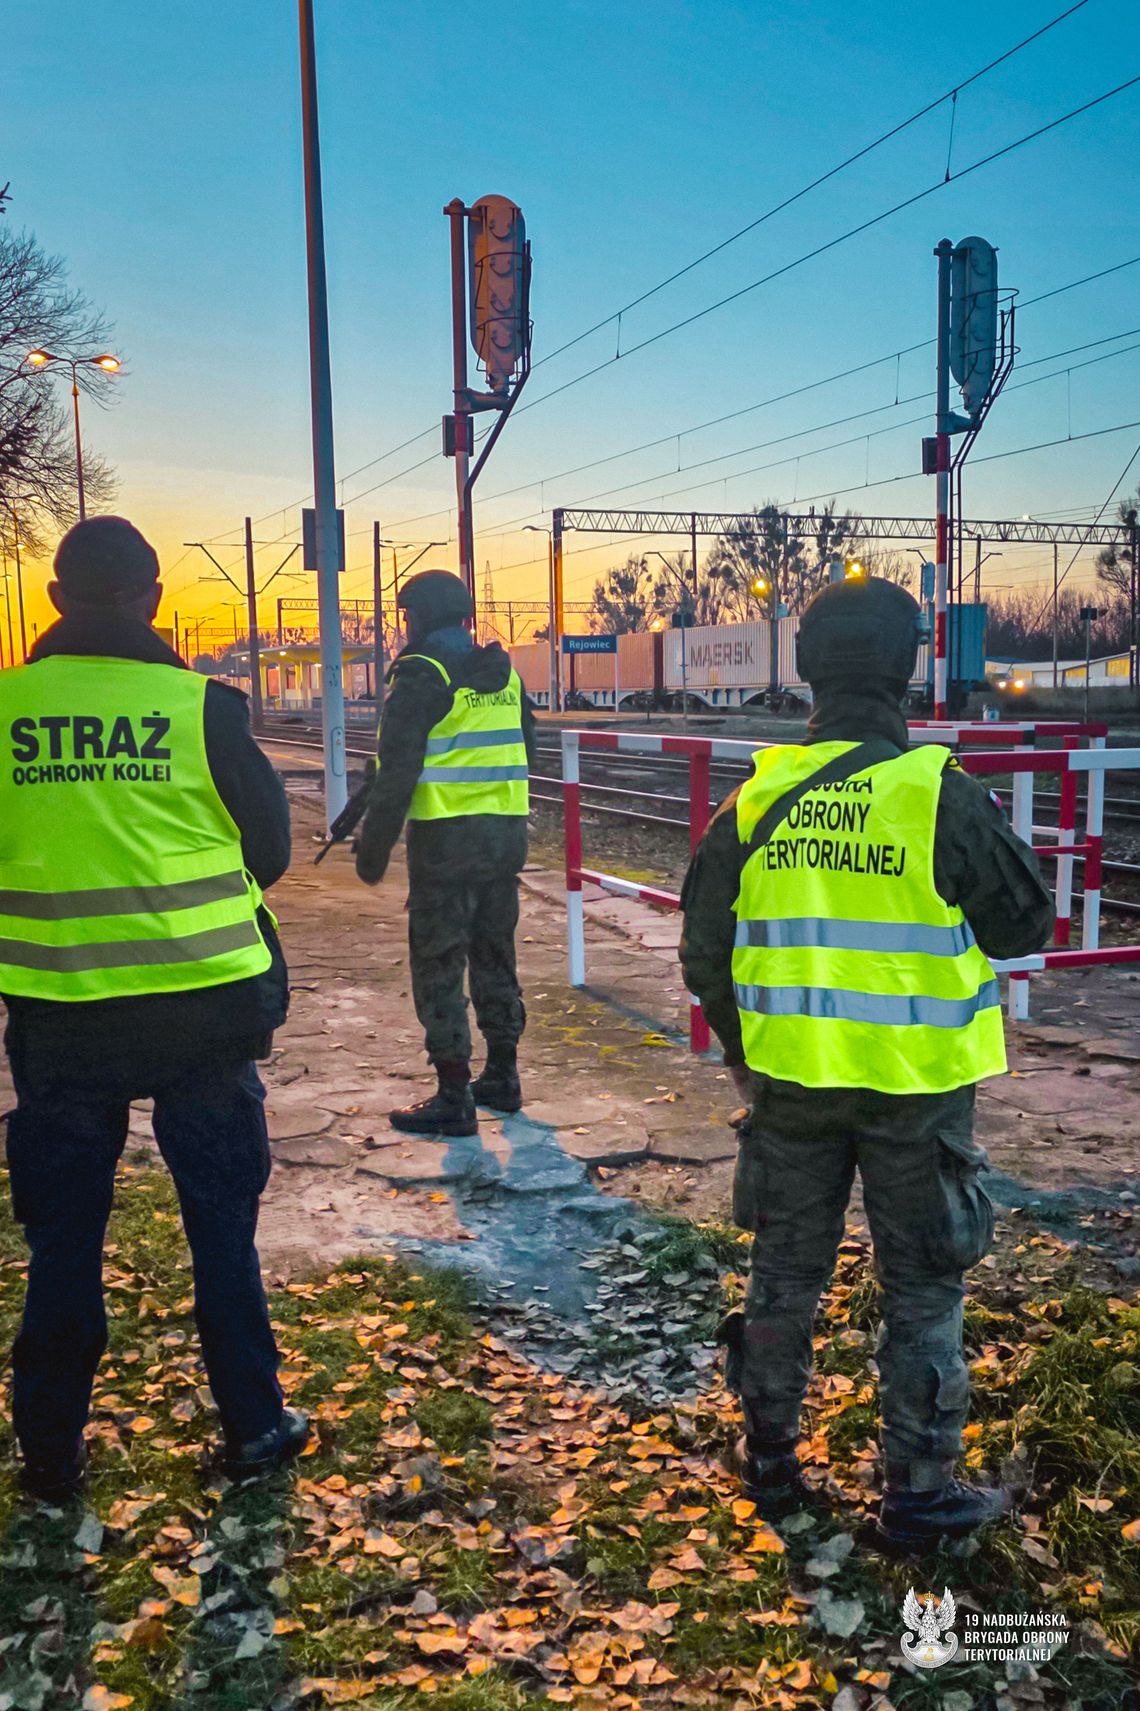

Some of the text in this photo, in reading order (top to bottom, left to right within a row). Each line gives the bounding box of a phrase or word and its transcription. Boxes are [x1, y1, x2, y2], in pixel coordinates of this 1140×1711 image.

[569, 640, 611, 651] Rejowiec
[690, 640, 755, 668] MAERSK
[10, 710, 172, 763] STRAŻ
[12, 763, 171, 786] OCHRONY KOLEI
[787, 799, 871, 833] OBRONY
